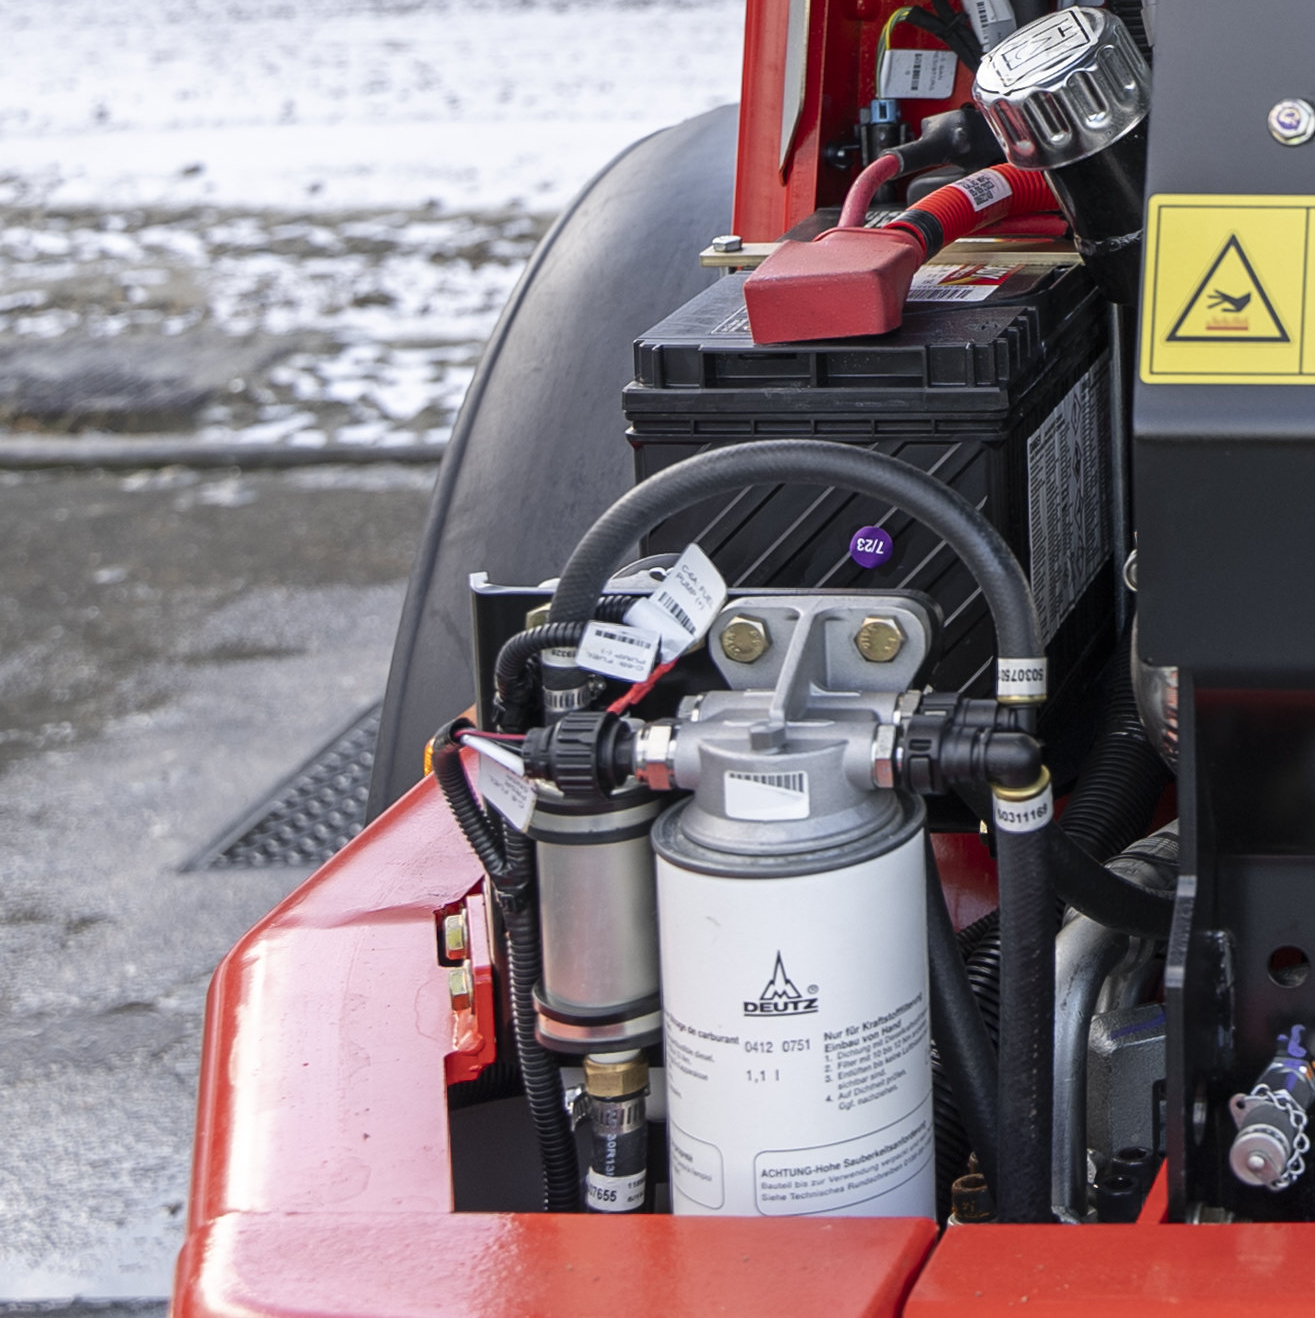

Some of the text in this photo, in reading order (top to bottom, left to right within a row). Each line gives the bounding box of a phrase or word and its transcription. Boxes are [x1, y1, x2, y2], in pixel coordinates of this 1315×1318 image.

[857, 538, 884, 554] 7/23
[744, 998, 818, 1013] DEUTZ
[698, 1030, 740, 1045] carburant
[823, 1030, 843, 1041] Nur
[845, 1025, 860, 1036] für
[824, 1019, 902, 1053] Einbau von Hand
[745, 1039, 811, 1053] 0412 0751
[837, 1044, 871, 1060] Dichtung
[837, 1058, 858, 1070] Filter
[746, 1069, 766, 1083] 1,1
[838, 1090, 852, 1100] Auf
[761, 1162, 841, 1178] ACHTUNG-Hohe
[761, 1179, 792, 1190] Bauteil
[794, 1179, 808, 1188] bis
[811, 1178, 826, 1186] zur
[829, 1163, 879, 1183] Verwendung
[761, 1163, 903, 1201] Siehe Technisches Rundschreiben
